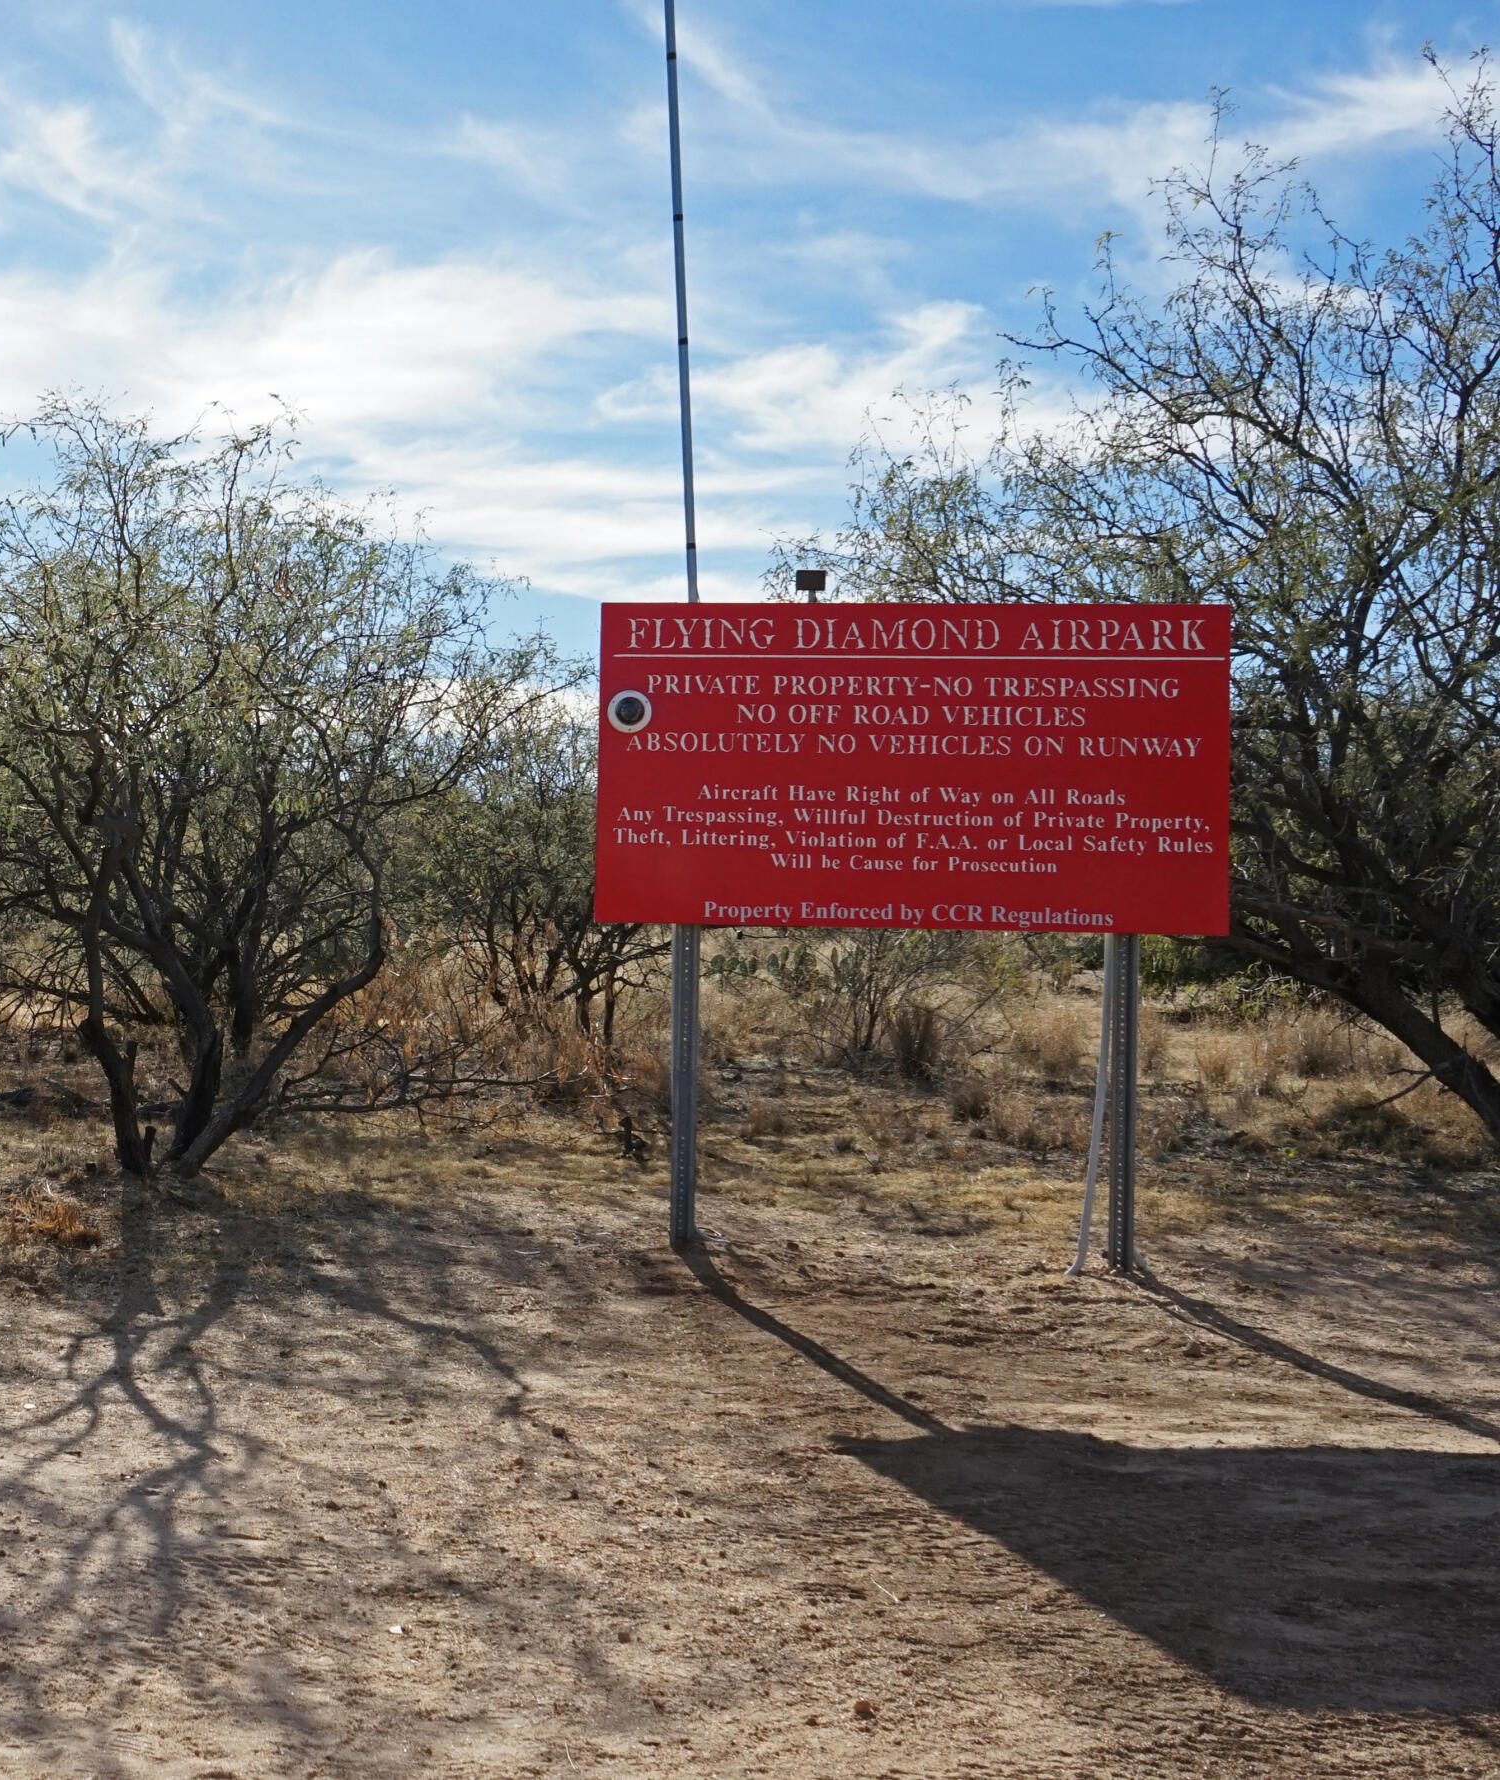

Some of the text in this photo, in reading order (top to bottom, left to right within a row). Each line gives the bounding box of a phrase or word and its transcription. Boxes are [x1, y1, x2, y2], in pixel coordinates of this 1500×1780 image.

[629, 619, 1206, 650] FLYING DIAMOND AIRPARK
[648, 675, 1180, 697] PRIVATE PROPERTY-NO TRESPASSING
[738, 704, 1087, 726] NO OFF ROAD VEHICLES
[626, 732, 1202, 756] ABSOLUTELY NO VEHICLES ON RUNWAY
[699, 784, 1127, 807] Aircraft Have Right of Way on All Roads
[618, 806, 1211, 832] Any Trespassing, Willful Destruction of Private Property,
[613, 828, 1214, 855] Theft, Littering, Violation of F.A.A. or Local Safety Rules
[771, 854, 1058, 872] Will be Cause for Prosecution
[705, 902, 1115, 926] Property Enforced by CCR Regulations
